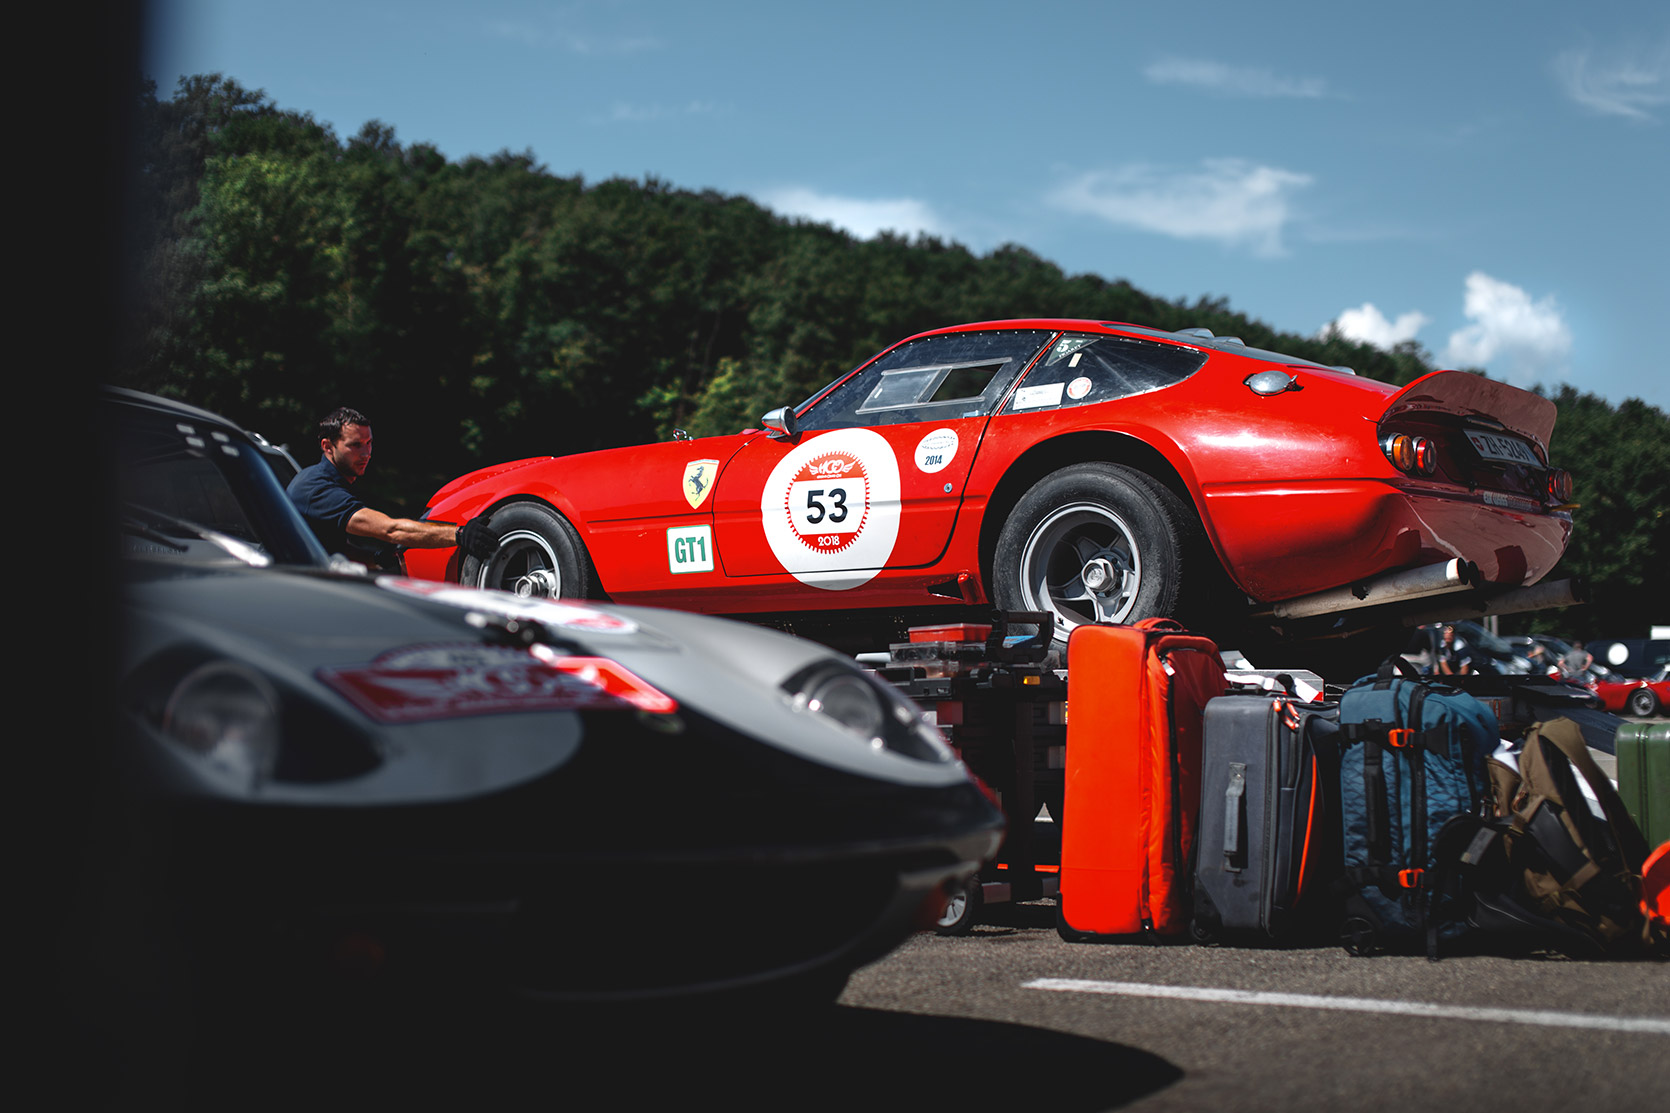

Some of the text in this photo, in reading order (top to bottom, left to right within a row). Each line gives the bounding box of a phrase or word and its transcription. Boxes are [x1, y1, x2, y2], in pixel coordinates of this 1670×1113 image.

[924, 454, 943, 466] 2014
[806, 487, 848, 524] 53
[674, 536, 706, 564] GT1
[817, 535, 840, 546] 2018
